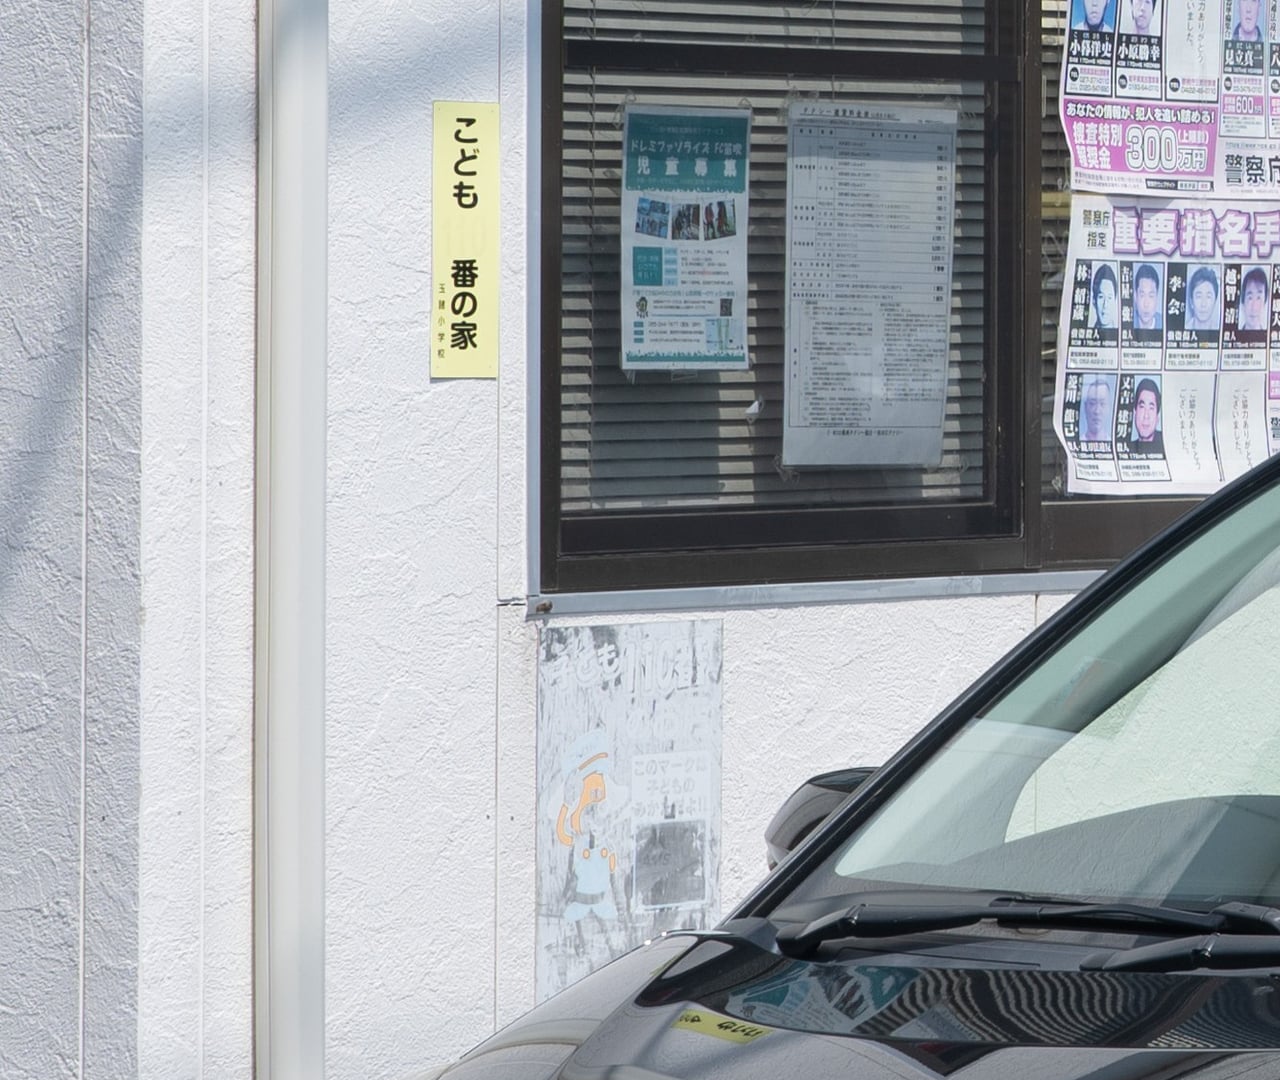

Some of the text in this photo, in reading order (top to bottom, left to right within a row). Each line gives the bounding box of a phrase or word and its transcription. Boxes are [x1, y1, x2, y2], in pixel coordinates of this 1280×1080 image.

[453, 117, 481, 210] こども
[1086, 231, 1107, 248] 指定
[450, 258, 479, 351] 番の家
